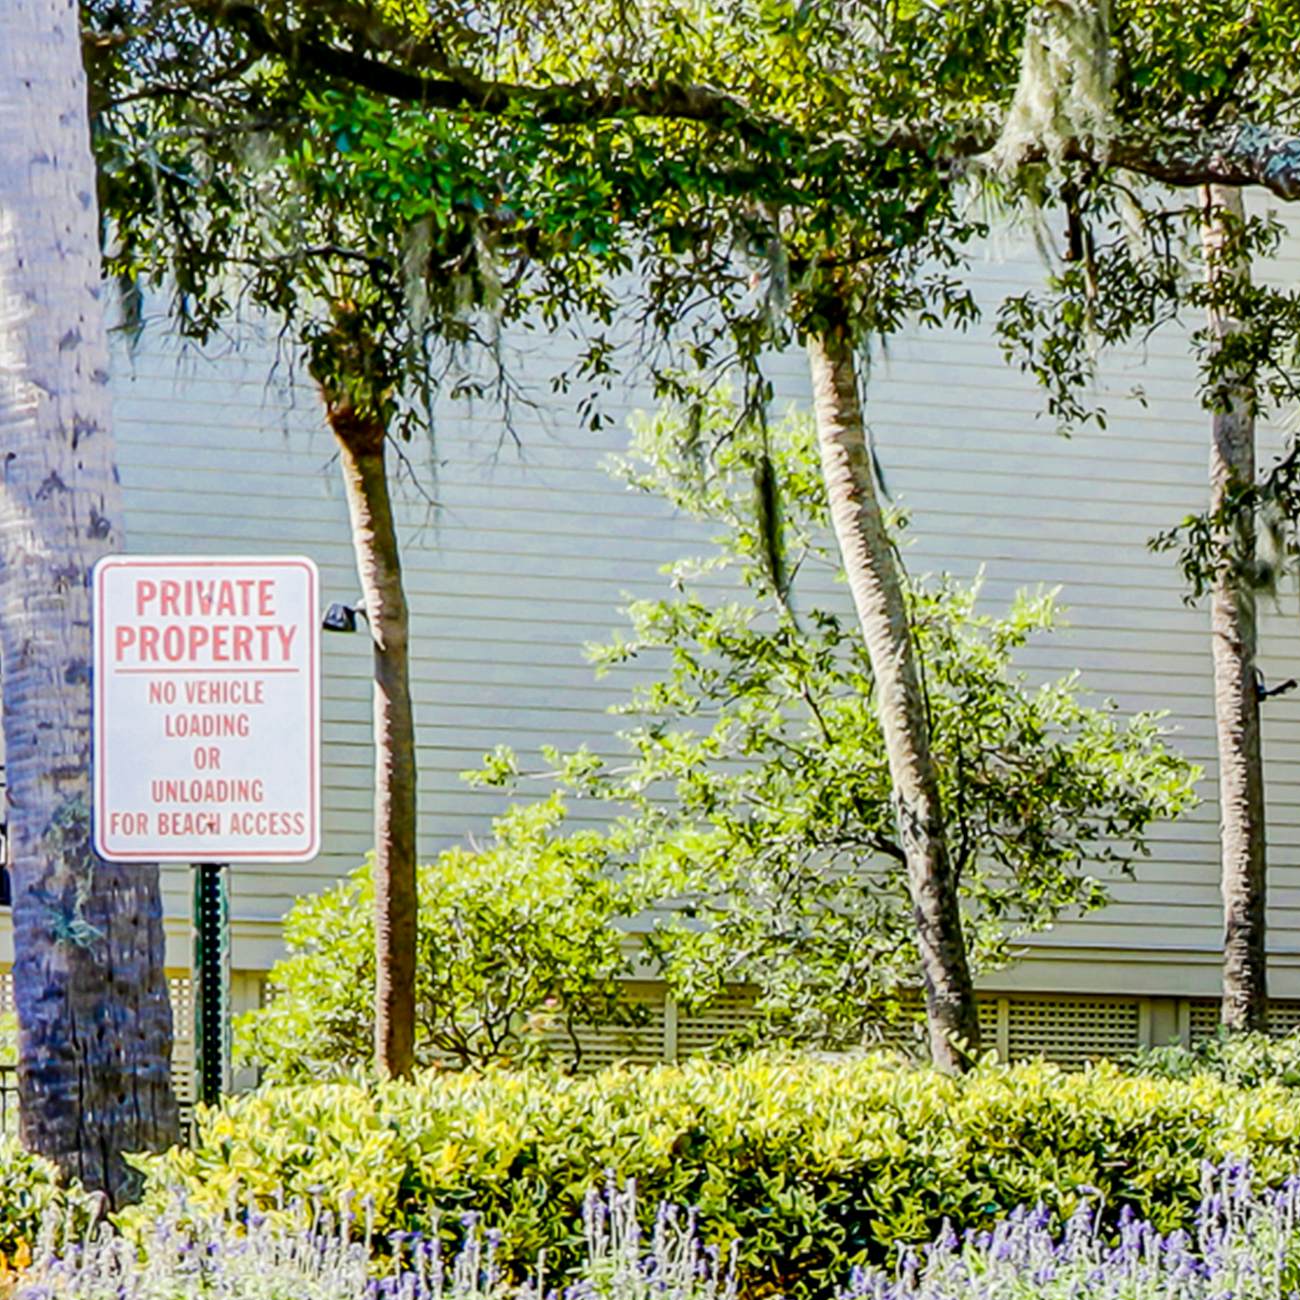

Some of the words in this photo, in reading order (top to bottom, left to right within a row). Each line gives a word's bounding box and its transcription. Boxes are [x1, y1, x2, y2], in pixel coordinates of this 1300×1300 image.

[136, 579, 276, 617] PRIVATE
[114, 623, 298, 663] PROPERTY
[149, 680, 177, 705] NO
[185, 680, 265, 705] VEHICLE
[165, 713, 250, 738] LOADING
[194, 746, 221, 770] OR
[152, 779, 264, 804] UNLOADING
[110, 812, 149, 836] FOR
[158, 812, 221, 836] BEACH
[229, 811, 305, 836] ACCESS
